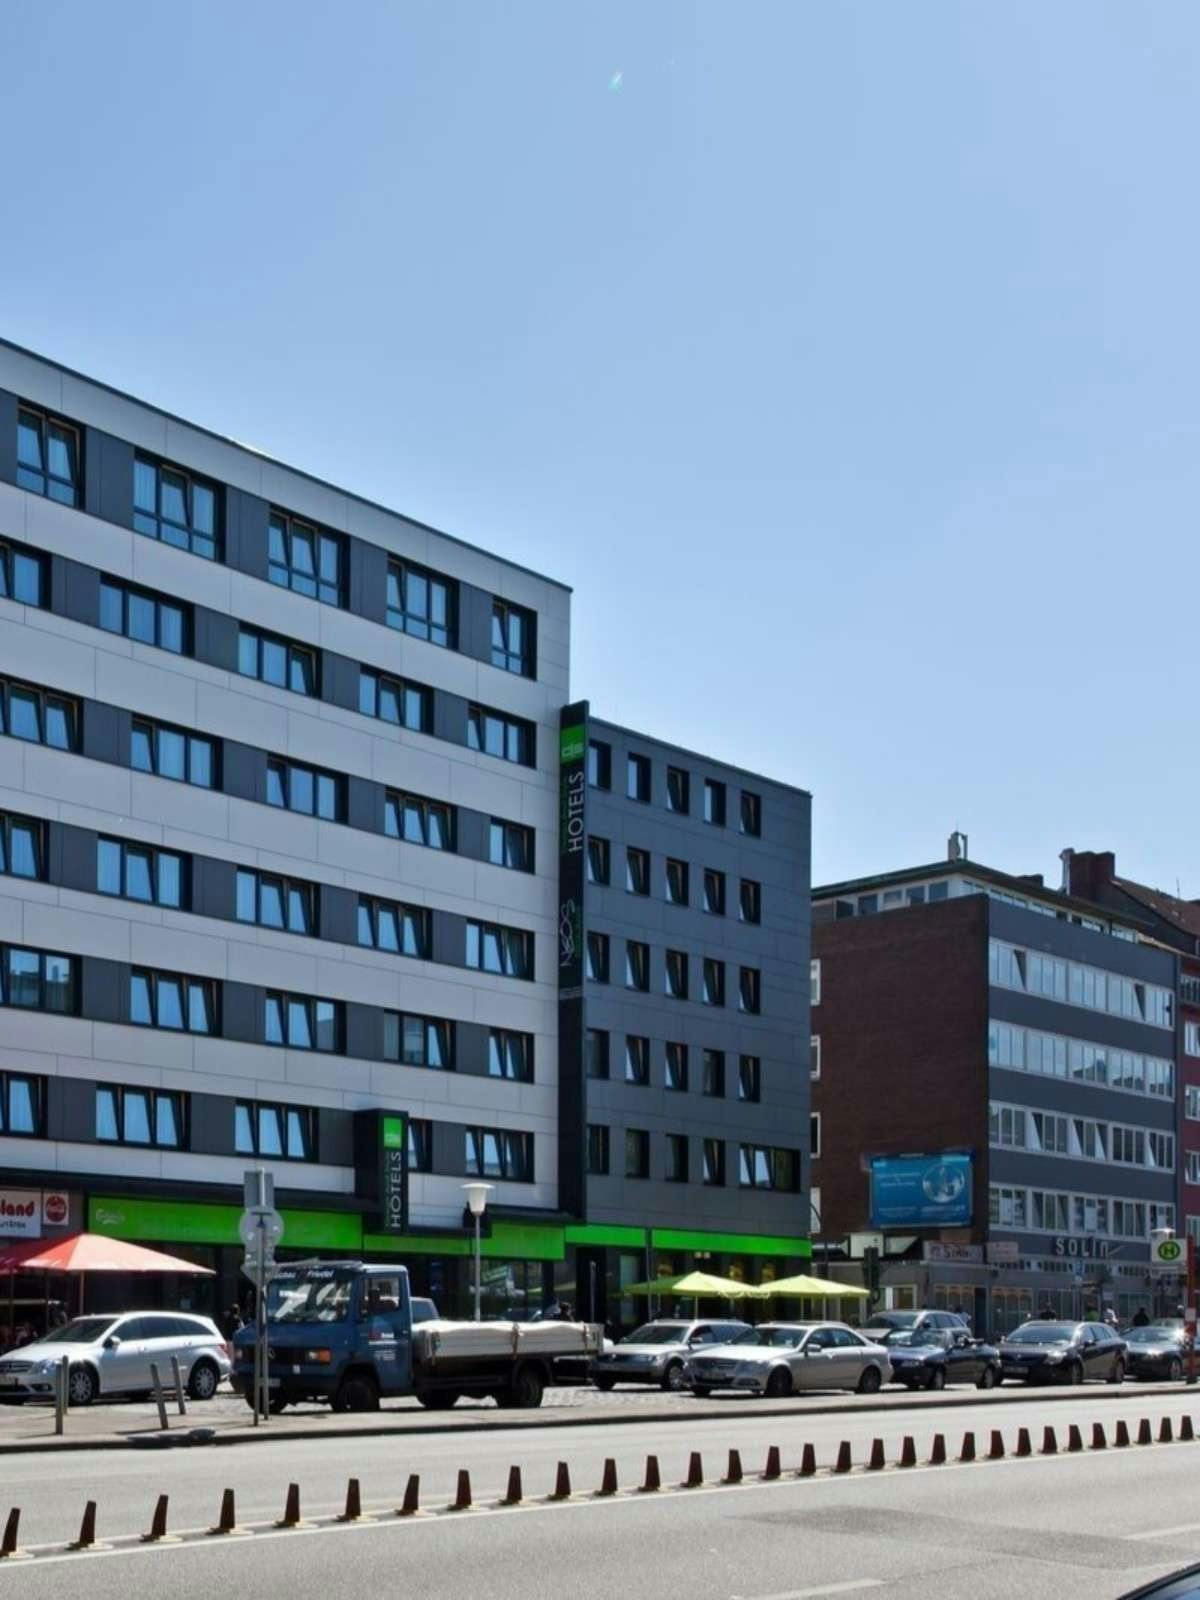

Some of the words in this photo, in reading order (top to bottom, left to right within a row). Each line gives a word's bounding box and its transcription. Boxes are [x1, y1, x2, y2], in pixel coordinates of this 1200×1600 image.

[568, 771, 584, 852] HOTELS
[390, 1151, 401, 1228] HOTELS
[1163, 1245, 1175, 1256] H
